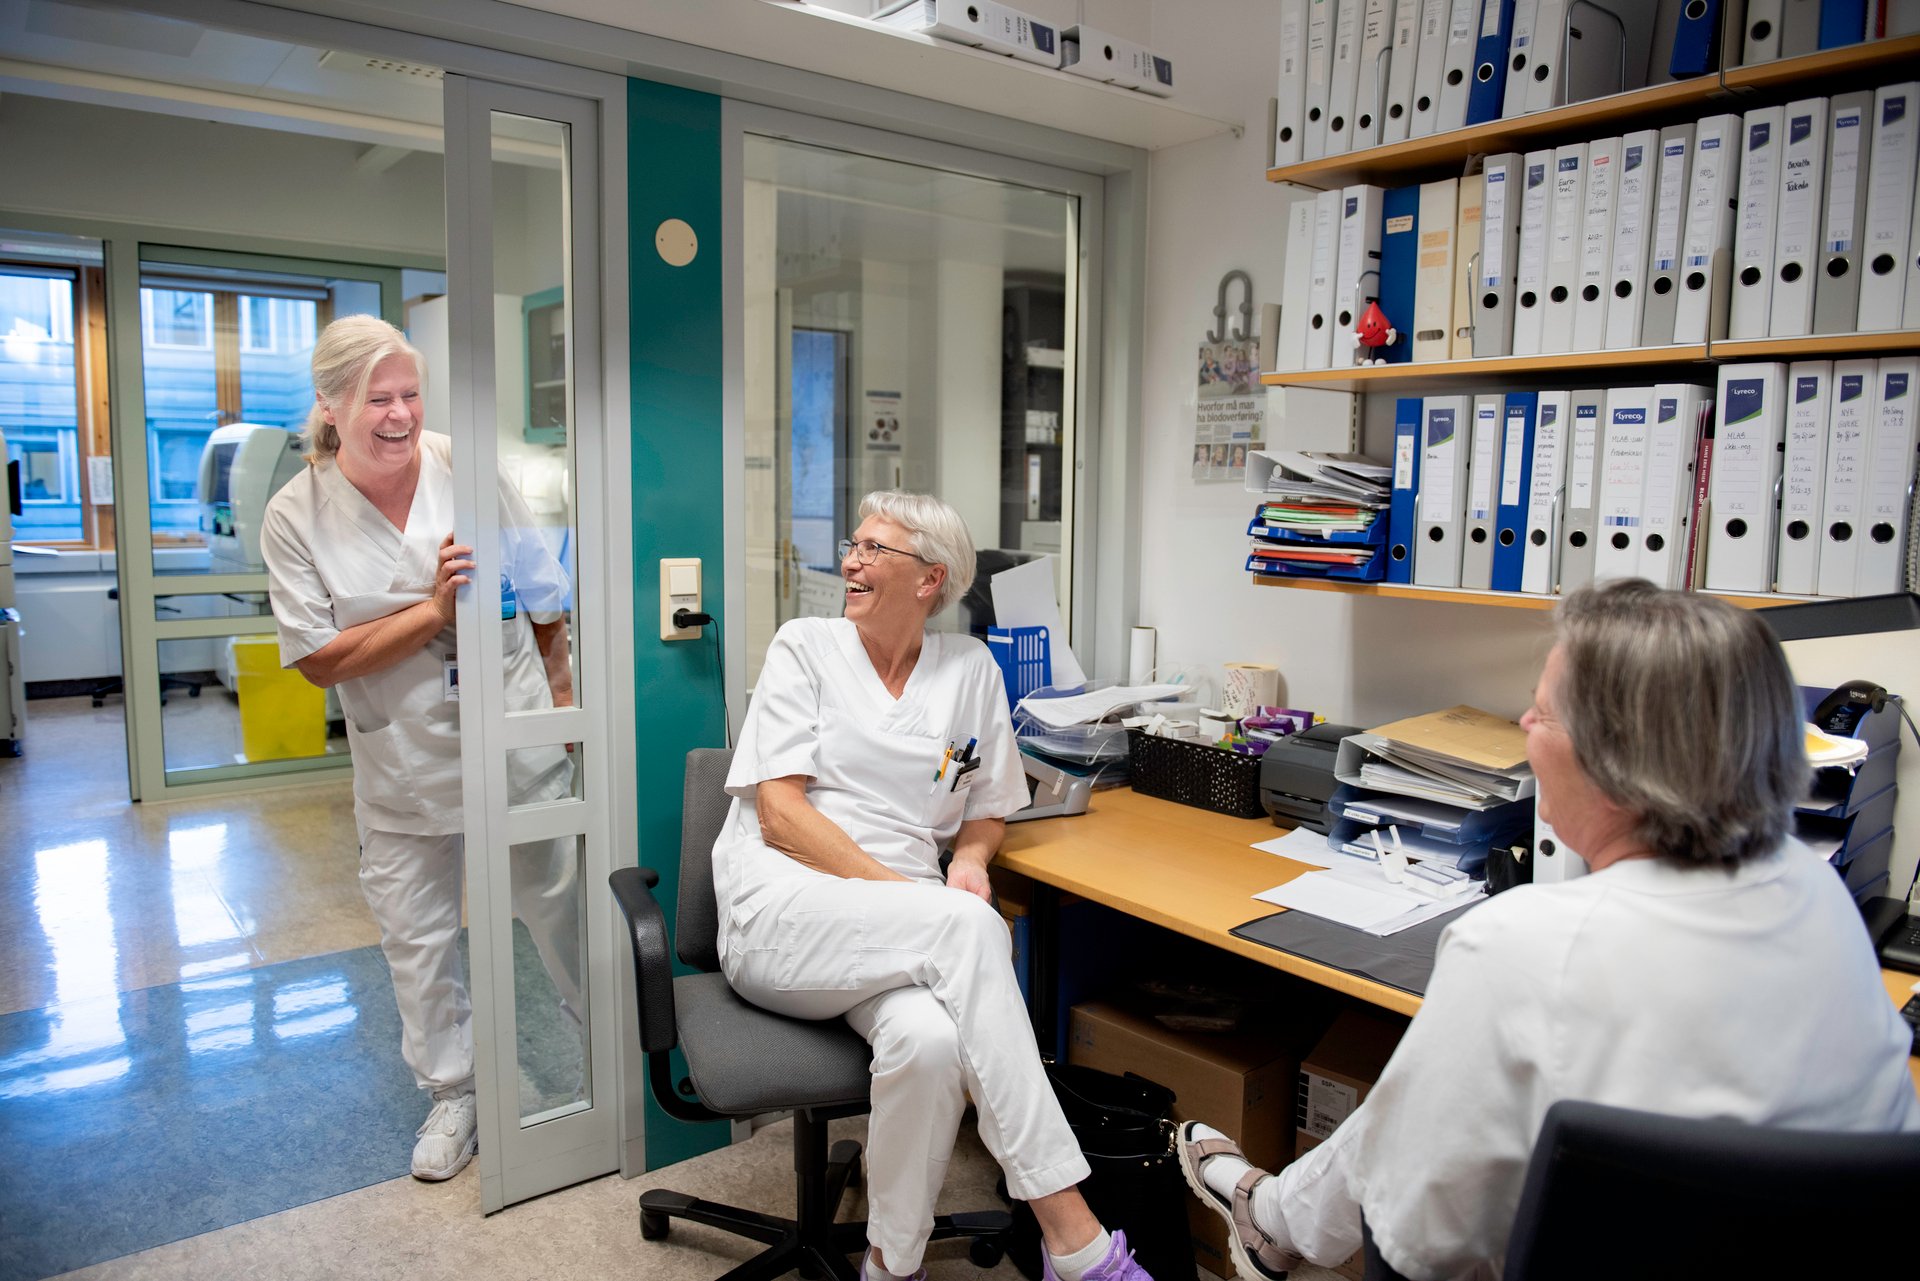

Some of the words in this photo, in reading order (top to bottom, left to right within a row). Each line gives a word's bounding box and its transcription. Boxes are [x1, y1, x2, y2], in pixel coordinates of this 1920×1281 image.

[1733, 388, 1756, 396] Lyreco
[1198, 401, 1224, 412] Hvorfor
[1226, 399, 1237, 410] må
[1239, 400, 1255, 410] man
[1207, 410, 1264, 423] blodoverføring?
[1616, 411, 1643, 421] Lyreco
